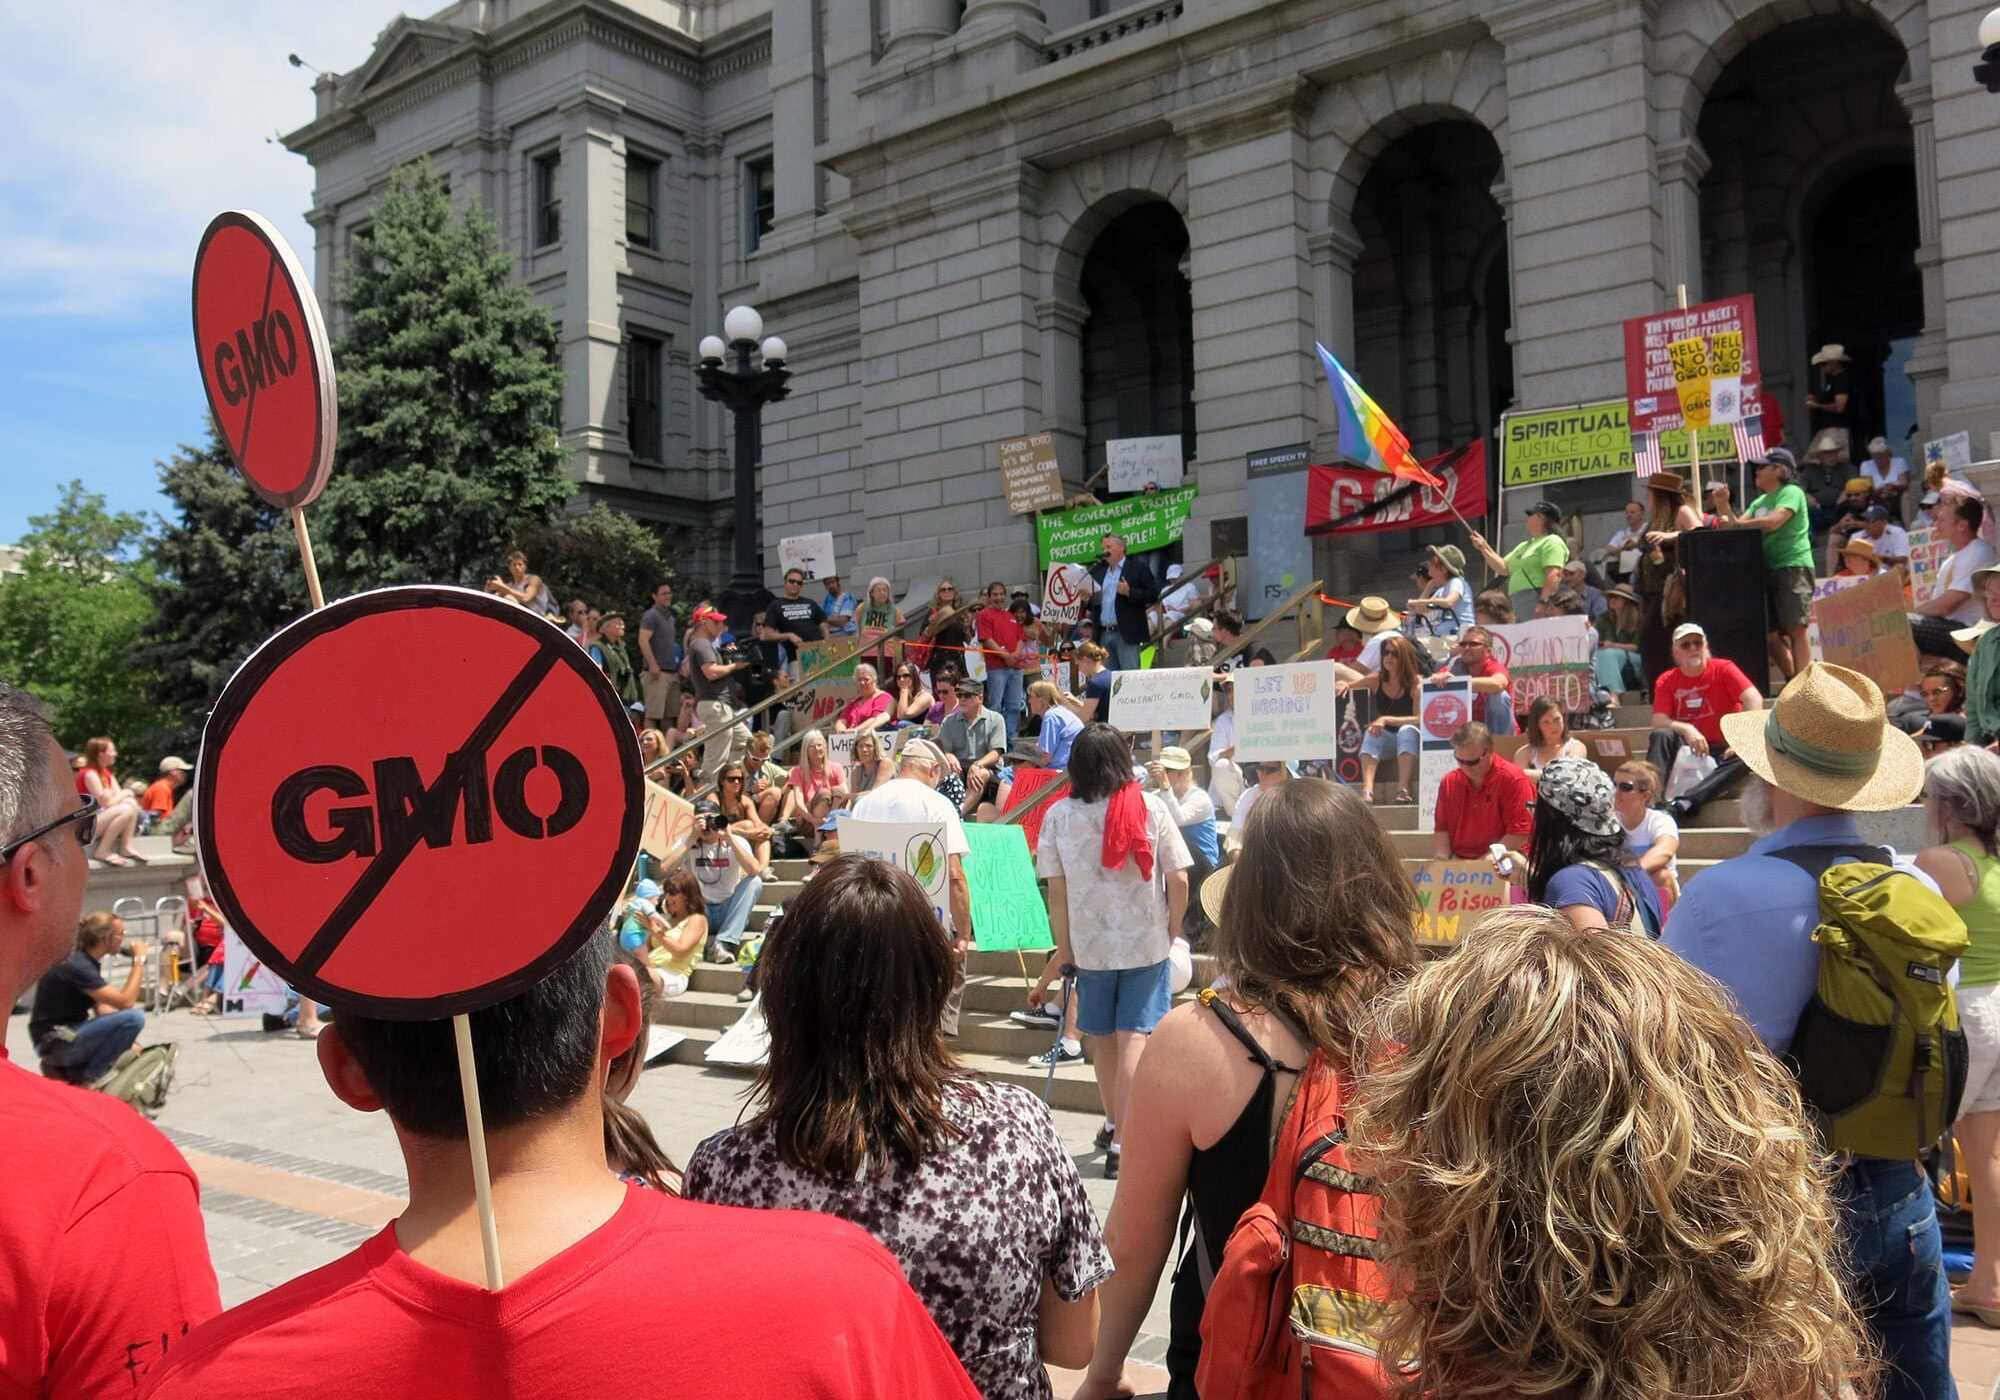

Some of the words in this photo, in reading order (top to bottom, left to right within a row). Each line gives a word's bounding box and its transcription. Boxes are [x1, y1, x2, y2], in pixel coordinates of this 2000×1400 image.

[1669, 340, 1704, 358] HELL
[1713, 336, 1741, 349] HELL
[214, 307, 298, 406] GMO
[1512, 411, 1628, 441] SPIRITUAL
[1250, 457, 1268, 467] FREE
[1269, 453, 1296, 464] SPEECH
[1297, 451, 1307, 460] TV
[1516, 433, 1578, 460] JUSTICE
[1588, 433, 1611, 448] TO
[1512, 464, 1522, 480] A
[1530, 455, 1611, 478] SPIRITUAL
[1330, 467, 1458, 525] GMO
[1042, 518, 1064, 529] THE
[1072, 503, 1134, 524] GOVERMENT
[1141, 489, 1196, 511] PROTECTS
[1050, 523, 1112, 543] MONSANTO
[1121, 511, 1157, 528] BEFORE
[1165, 506, 1178, 518] IT
[1050, 541, 1096, 561] PROTECTS
[1043, 601, 1060, 622] Say
[1060, 606, 1079, 621] NO!
[1254, 675, 1283, 694] LET
[1293, 672, 1317, 693] US
[272, 744, 590, 864] GMO
[974, 859, 1025, 891] OVER
[1443, 868, 1493, 885] horn
[1438, 888, 1502, 913] Poison
